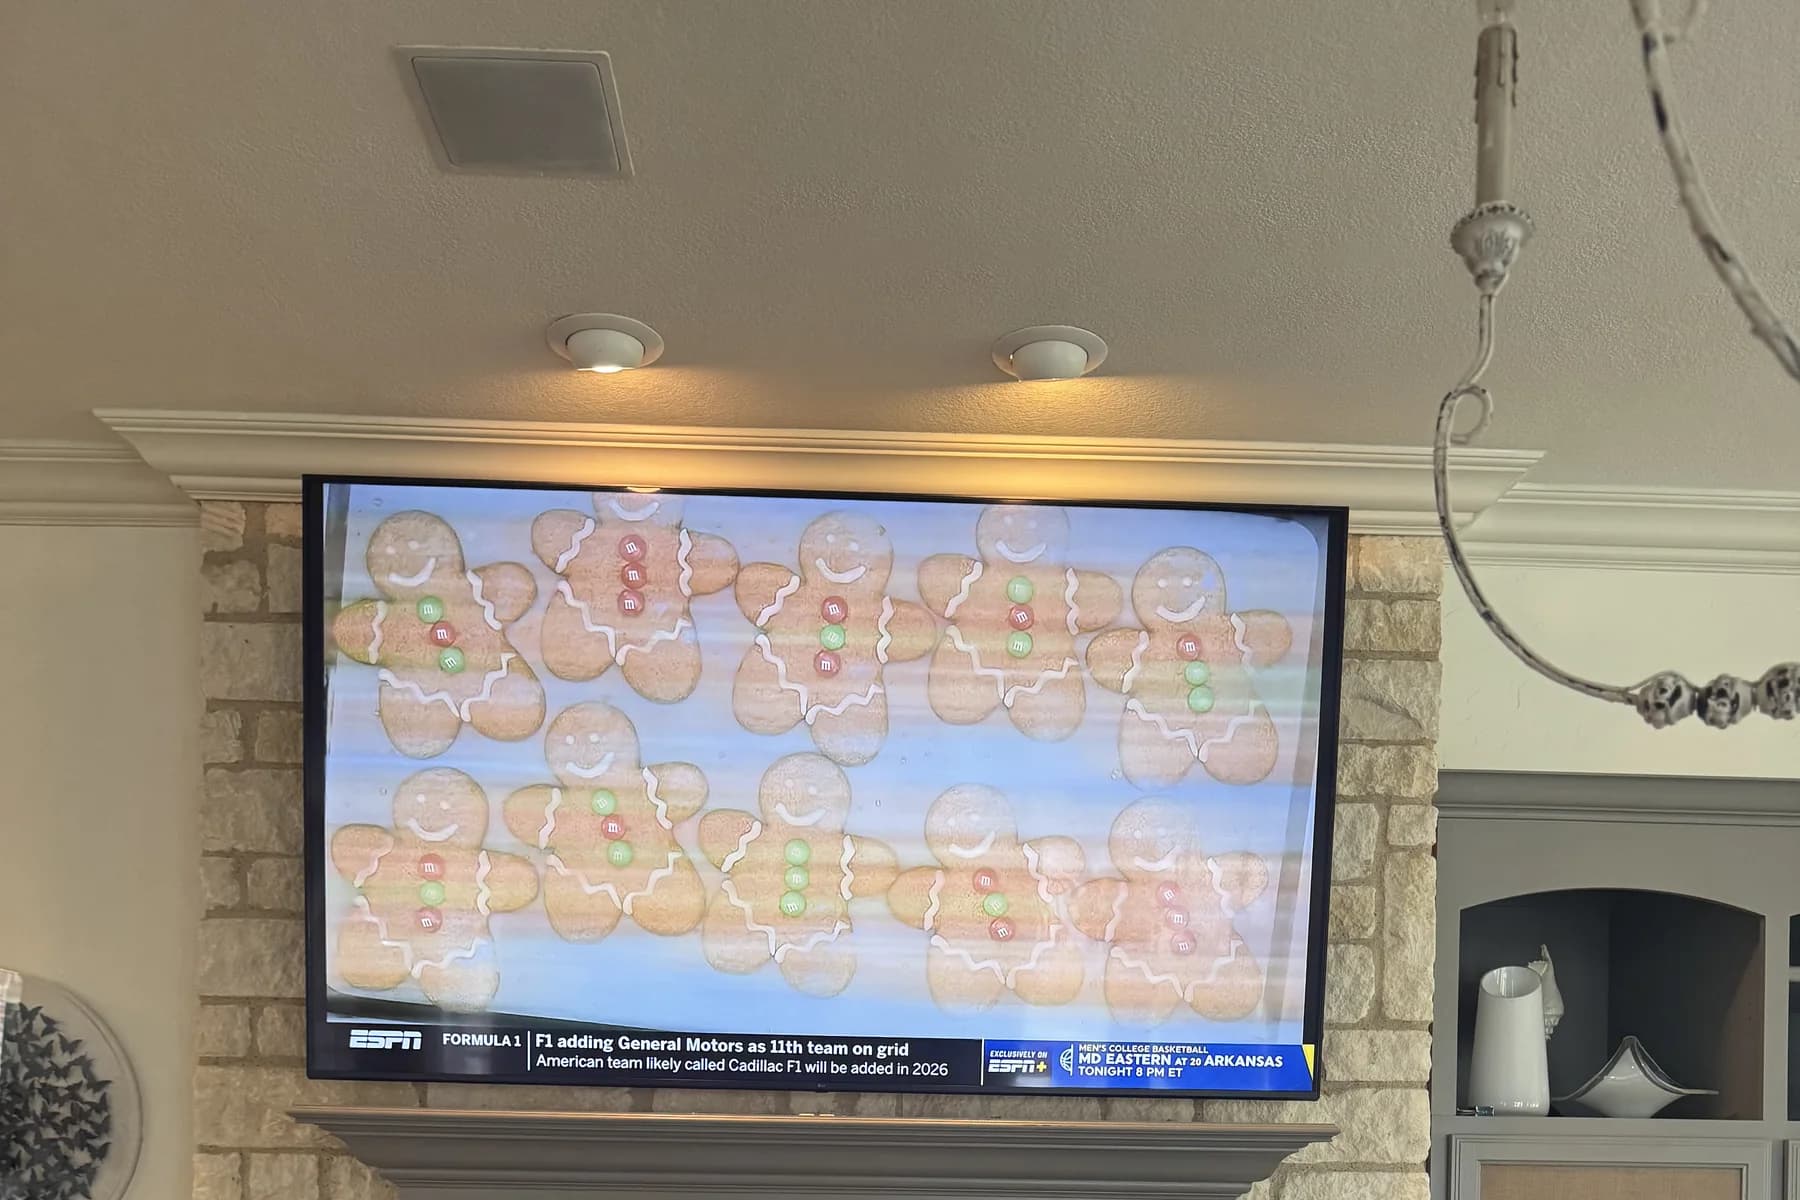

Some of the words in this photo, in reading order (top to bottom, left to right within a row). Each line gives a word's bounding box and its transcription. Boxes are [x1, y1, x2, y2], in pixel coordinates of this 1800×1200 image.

[626, 541, 639, 553] m
[628, 569, 640, 581] m
[624, 598, 636, 610] m
[828, 603, 840, 615] m
[1016, 611, 1028, 623] m
[436, 628, 448, 640] m
[1184, 640, 1196, 652] m
[445, 656, 457, 668] m
[821, 659, 831, 671] m
[608, 822, 618, 833] m
[424, 862, 436, 873] m
[980, 875, 992, 886] m
[787, 902, 798, 913] m
[421, 917, 433, 928] m
[1173, 914, 1183, 924] m
[997, 926, 1009, 938] m
[349, 1029, 422, 1050] ESPN
[442, 1033, 512, 1047] FORMULA
[514, 1035, 522, 1047] 1
[535, 1035, 553, 1048] F1
[557, 1036, 614, 1053] adding
[617, 1036, 682, 1052] General
[686, 1038, 744, 1053] Motors
[747, 1042, 766, 1053] as
[770, 1039, 803, 1054] 11th
[807, 1041, 849, 1055] team
[852, 1044, 873, 1056] on
[876, 1042, 909, 1059] grid
[1078, 1044, 1107, 1053] MEN'S
[1108, 1045, 1151, 1053] COLLEGE
[1152, 1045, 1209, 1054] BASKETBALL
[989, 1050, 1036, 1059] EXCLUSIVELY
[1038, 1051, 1048, 1059] ON
[535, 1054, 604, 1069] American
[607, 1056, 643, 1070] team
[646, 1057, 682, 1073] likely
[684, 1058, 725, 1072] called
[728, 1058, 784, 1073] Cadillac
[787, 1060, 802, 1073] F1
[804, 1060, 827, 1074] will
[831, 1061, 848, 1074] be
[850, 1061, 894, 1075] added
[896, 1062, 910, 1075] in
[913, 1062, 949, 1076] 2026
[1078, 1054, 1102, 1065] MD
[1105, 1054, 1171, 1066] EASTERN
[1174, 1057, 1188, 1066] AT
[1190, 1058, 1202, 1066] 20
[1204, 1055, 1283, 1068] ARKANSAS
[1078, 1066, 1134, 1078] TONIGHT
[1136, 1066, 1144, 1078] 8
[1146, 1067, 1165, 1078] PM
[1167, 1067, 1183, 1078] ET
